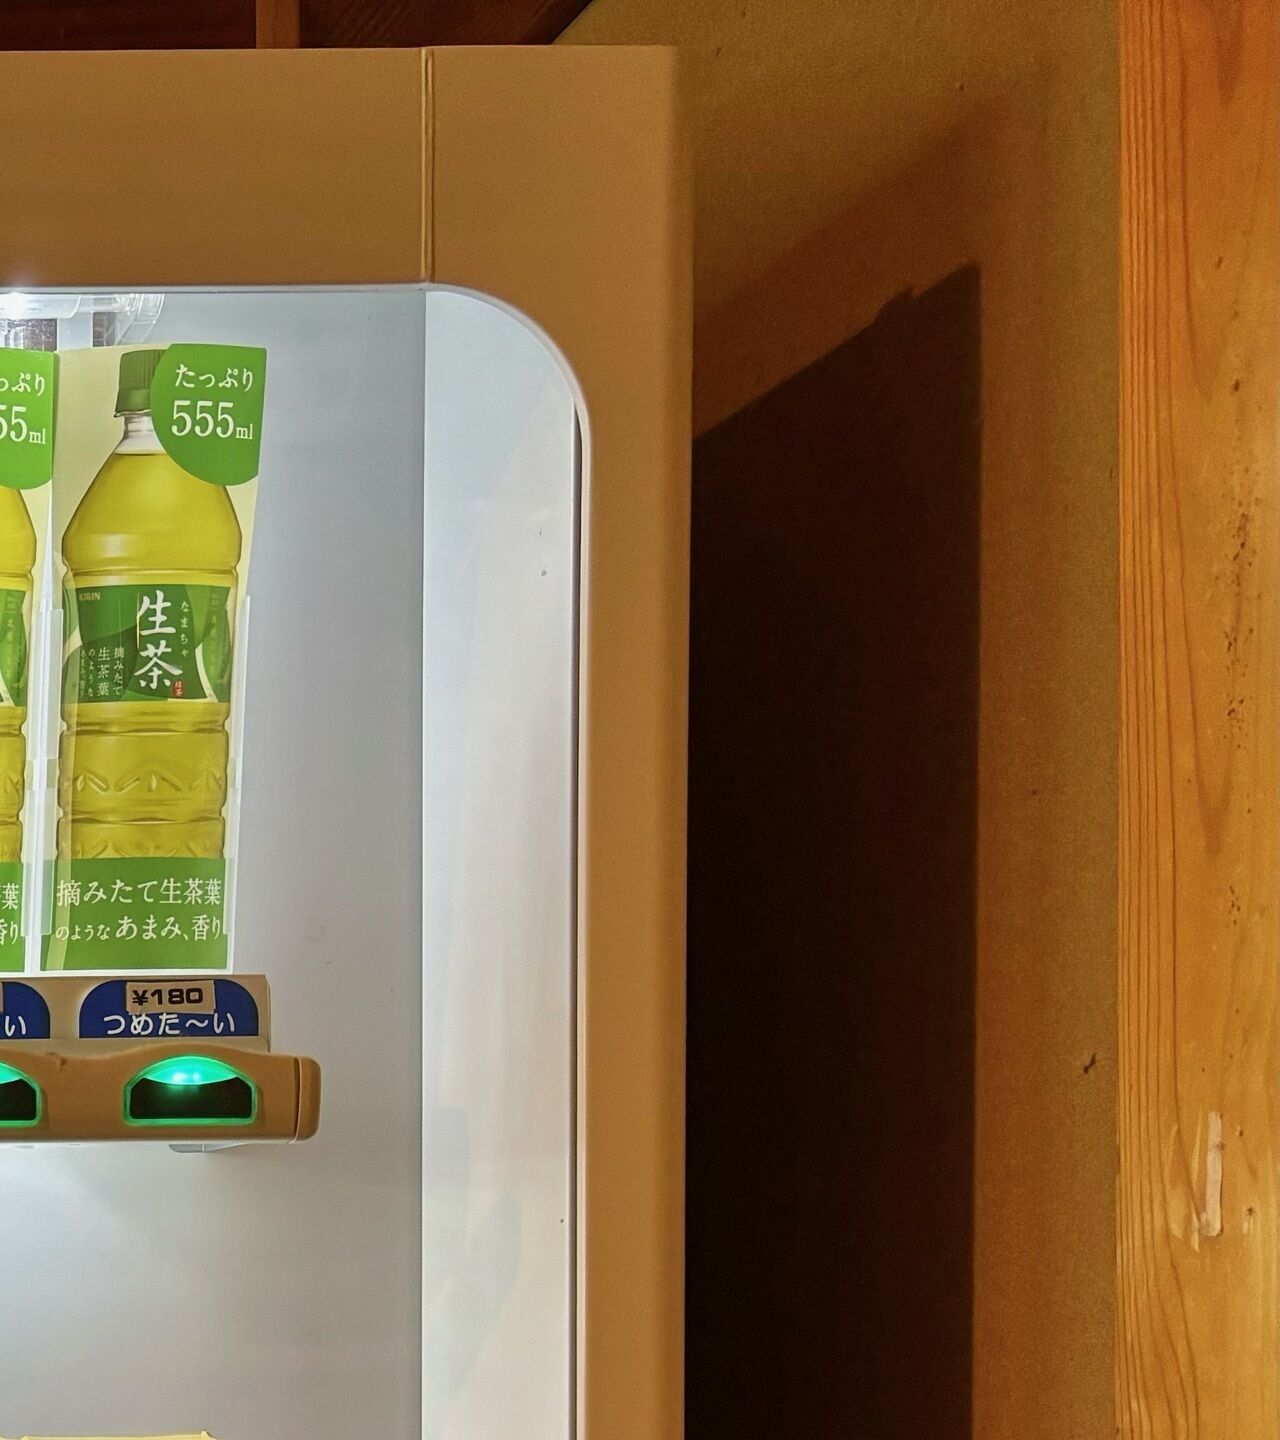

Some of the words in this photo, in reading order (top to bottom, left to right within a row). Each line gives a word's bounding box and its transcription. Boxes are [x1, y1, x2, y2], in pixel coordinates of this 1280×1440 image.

[175, 364, 253, 389] たっぷり
[171, 400, 253, 440] 555ml
[134, 590, 183, 690] 生茶
[57, 878, 222, 907] 摘みたて生茶葉
[132, 988, 203, 1005] ¥180
